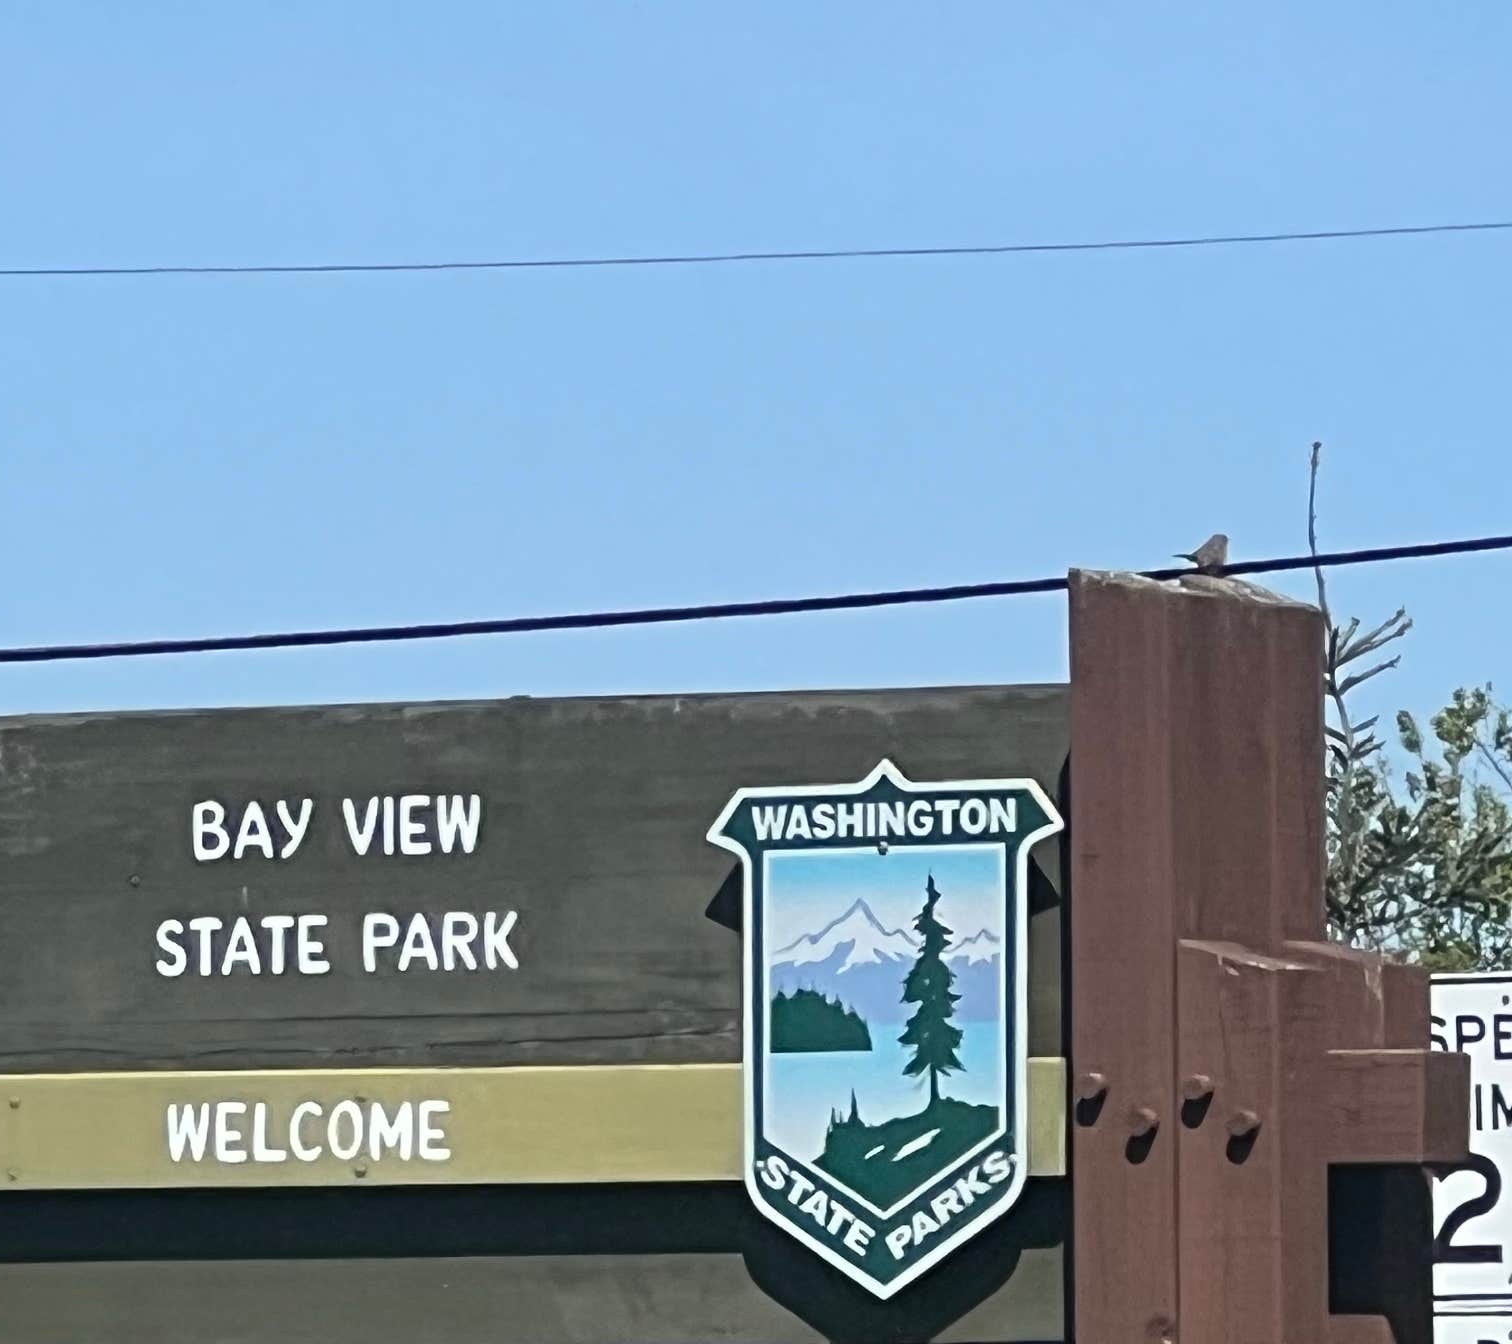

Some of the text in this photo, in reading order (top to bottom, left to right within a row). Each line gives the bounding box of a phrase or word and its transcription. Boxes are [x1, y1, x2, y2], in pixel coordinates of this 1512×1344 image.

[192, 793, 481, 861] BAY VIEW
[751, 797, 1017, 842] WASHINGTON
[155, 910, 519, 977] STATE PARK
[167, 1100, 451, 1163] WELCOME
[760, 1150, 1012, 1260] STATE PARKS
